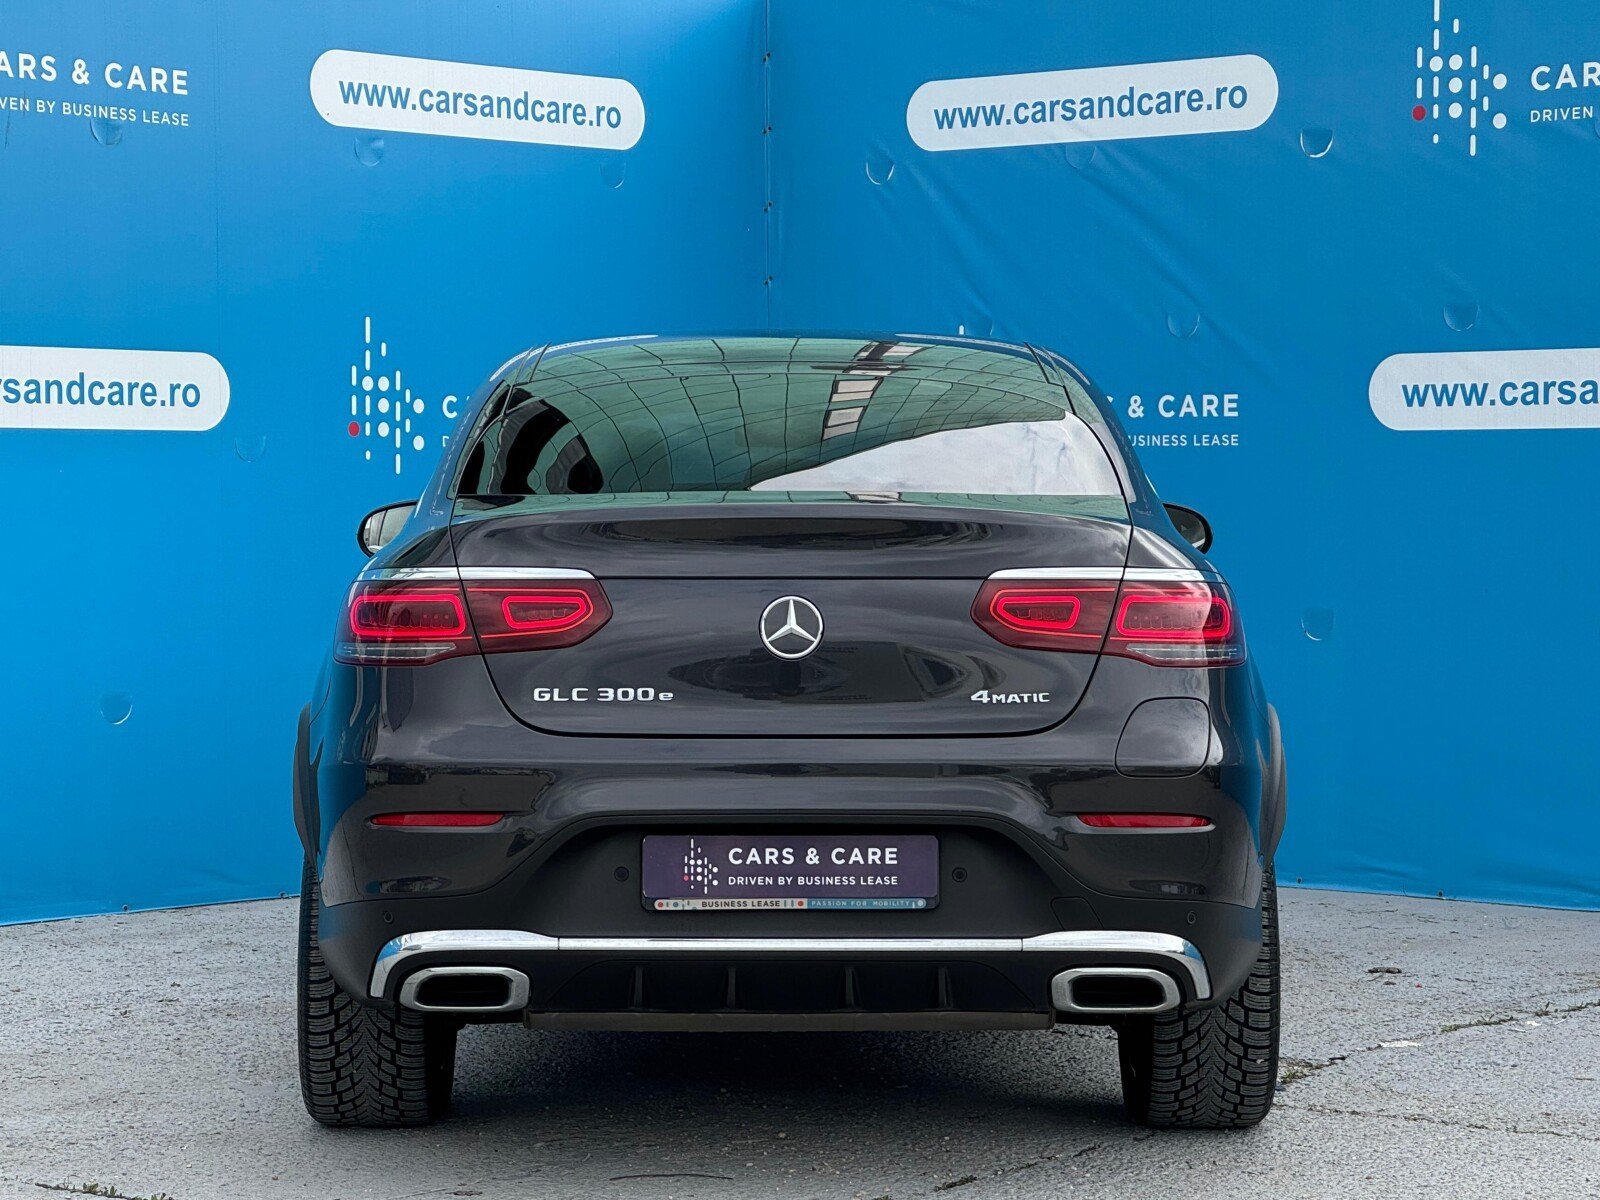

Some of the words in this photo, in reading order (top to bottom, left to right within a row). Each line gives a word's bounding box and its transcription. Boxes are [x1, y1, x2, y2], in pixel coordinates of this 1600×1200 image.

[71, 58, 90, 85] &
[104, 62, 188, 96] CARE
[1530, 61, 1600, 91] CAR
[36, 99, 55, 114] BY
[62, 102, 137, 122] BUSINESS
[142, 110, 189, 127] LEASE
[338, 80, 621, 129] www.carsandcare.ro
[933, 85, 1248, 130] www.carsandcare.ro
[1530, 105, 1593, 123] DRIVEN
[0, 371, 201, 408] sandcare.ro
[1401, 379, 1599, 407] www.carsa
[1127, 395, 1145, 418] &
[1158, 393, 1239, 418] CARE
[1193, 434, 1239, 447] LEASE
[533, 687, 589, 702] GLC
[597, 687, 674, 701] 300e
[970, 690, 1051, 704] 4MATIC
[728, 847, 795, 865] CARS
[805, 847, 820, 865] &
[831, 847, 899, 865] CARE
[728, 876, 774, 885] DRIVEN
[778, 876, 793, 885] BY
[797, 876, 856, 885] BUSINESS
[860, 876, 899, 885] LEASE
[701, 900, 748, 908] BUSINESS
